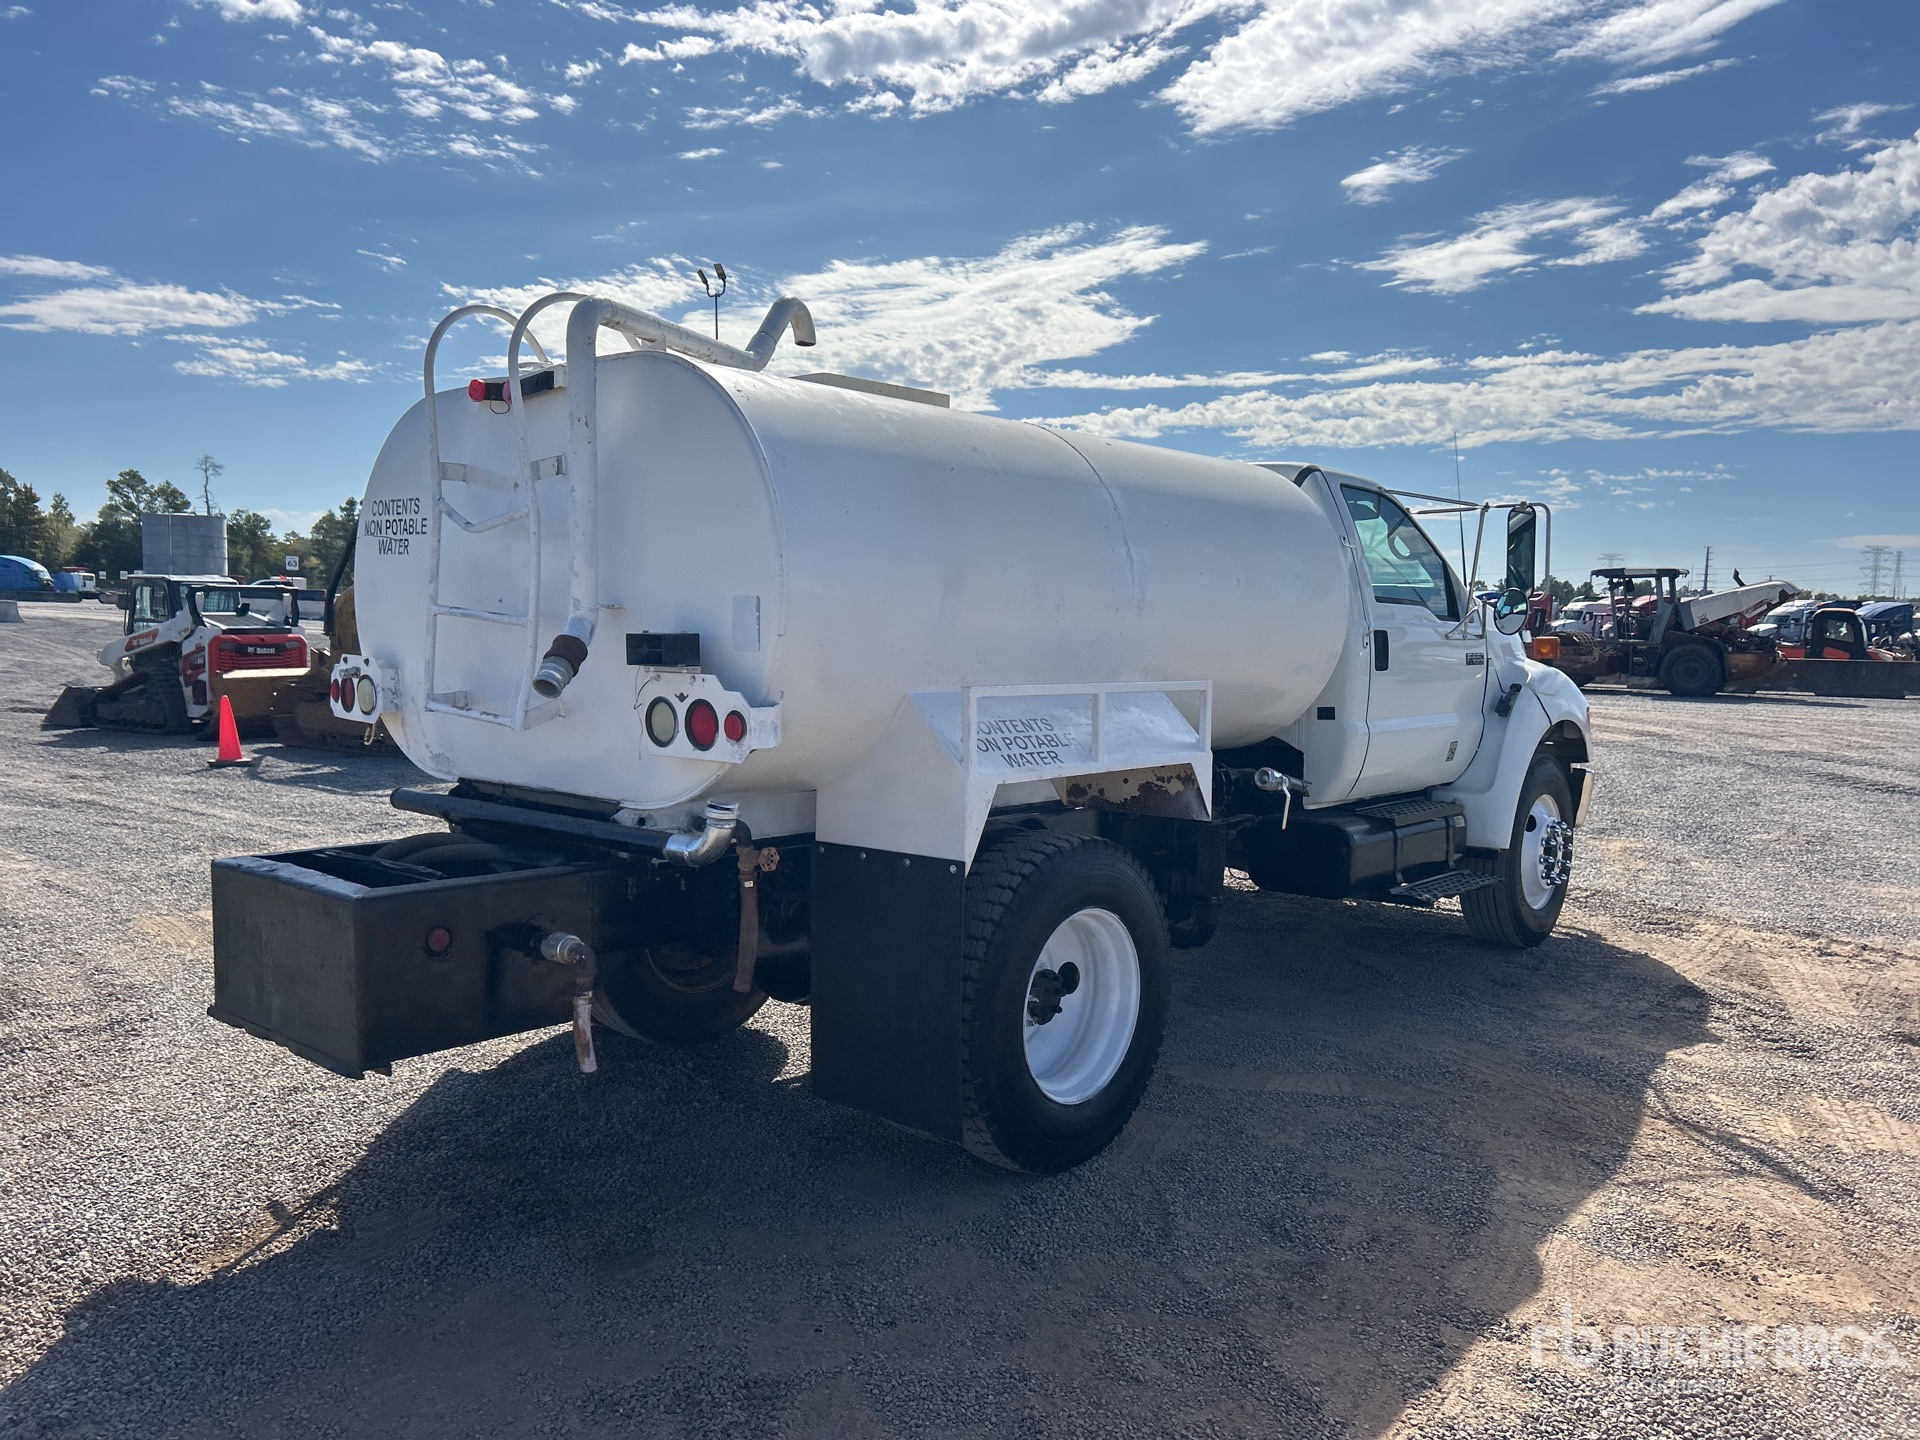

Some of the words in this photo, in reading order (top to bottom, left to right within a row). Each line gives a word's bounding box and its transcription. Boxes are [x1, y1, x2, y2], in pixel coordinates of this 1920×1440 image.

[371, 497, 420, 516] CONTENTS
[364, 519, 383, 536] NON
[385, 518, 427, 535] POTABLE
[378, 538, 410, 555] WATER
[287, 560, 298, 568] 63
[977, 718, 1055, 735] ONTENTS
[977, 737, 1002, 752] ON
[1001, 750, 1064, 768] WATER
